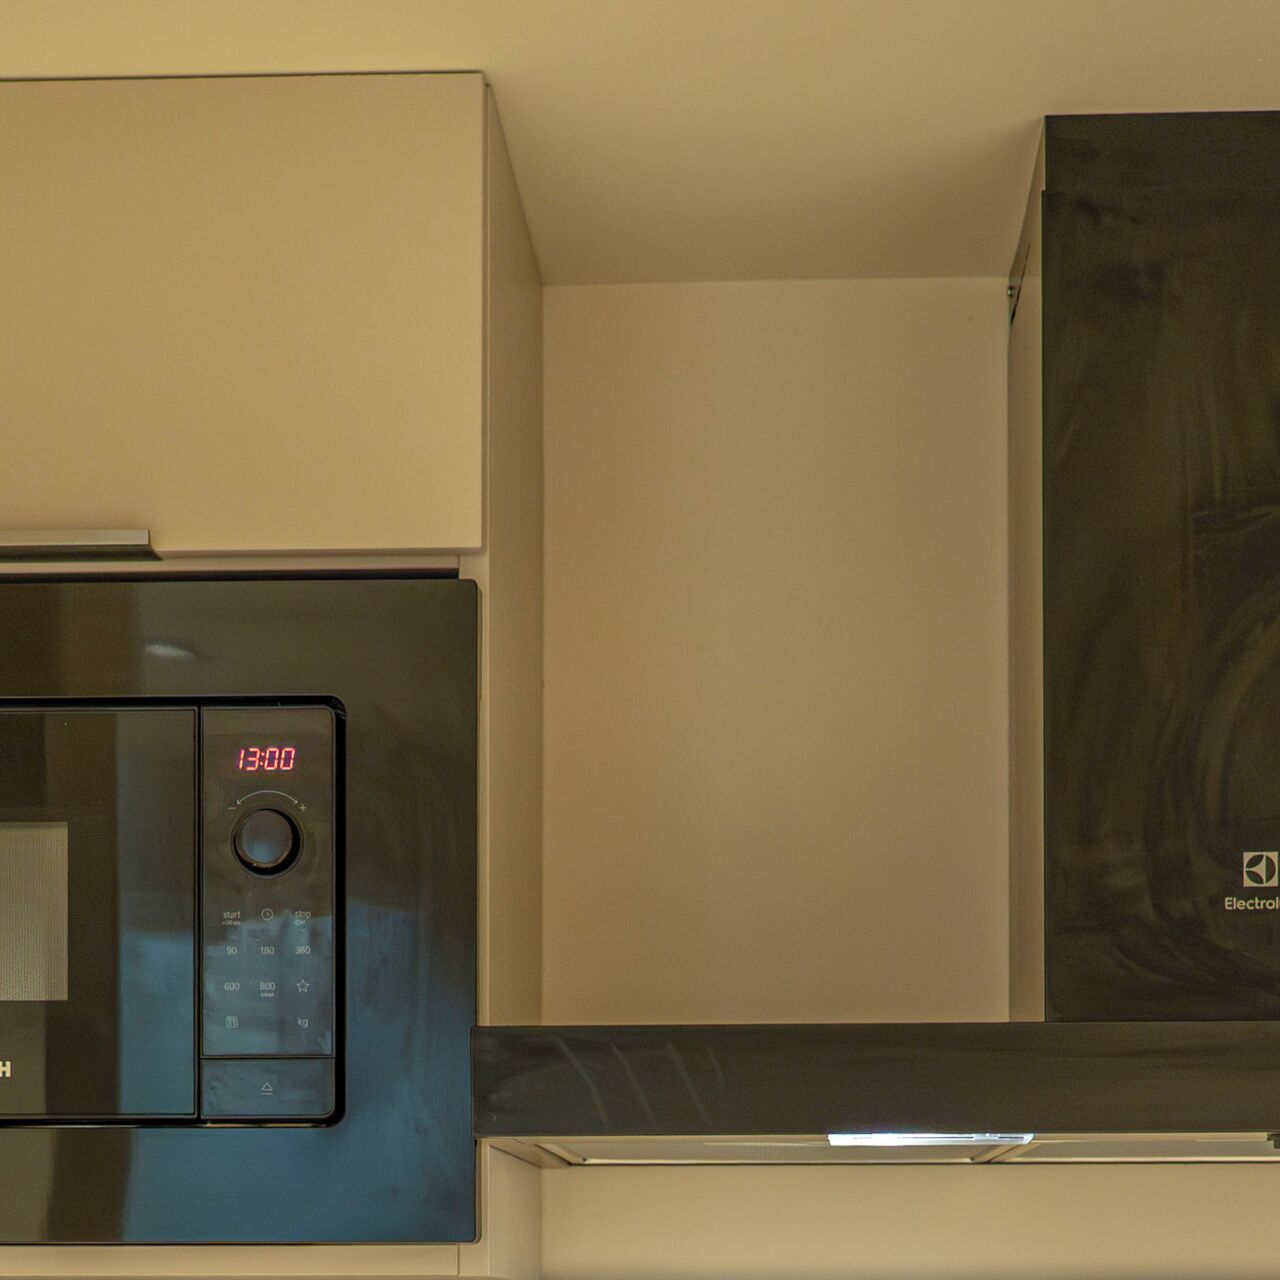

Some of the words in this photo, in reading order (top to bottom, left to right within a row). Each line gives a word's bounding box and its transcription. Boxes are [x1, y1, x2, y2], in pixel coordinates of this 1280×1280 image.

[238, 748, 296, 771] 13:00
[223, 911, 241, 919] start
[295, 911, 312, 920] stop
[226, 945, 238, 956] 90
[297, 1016, 309, 1029] kg
